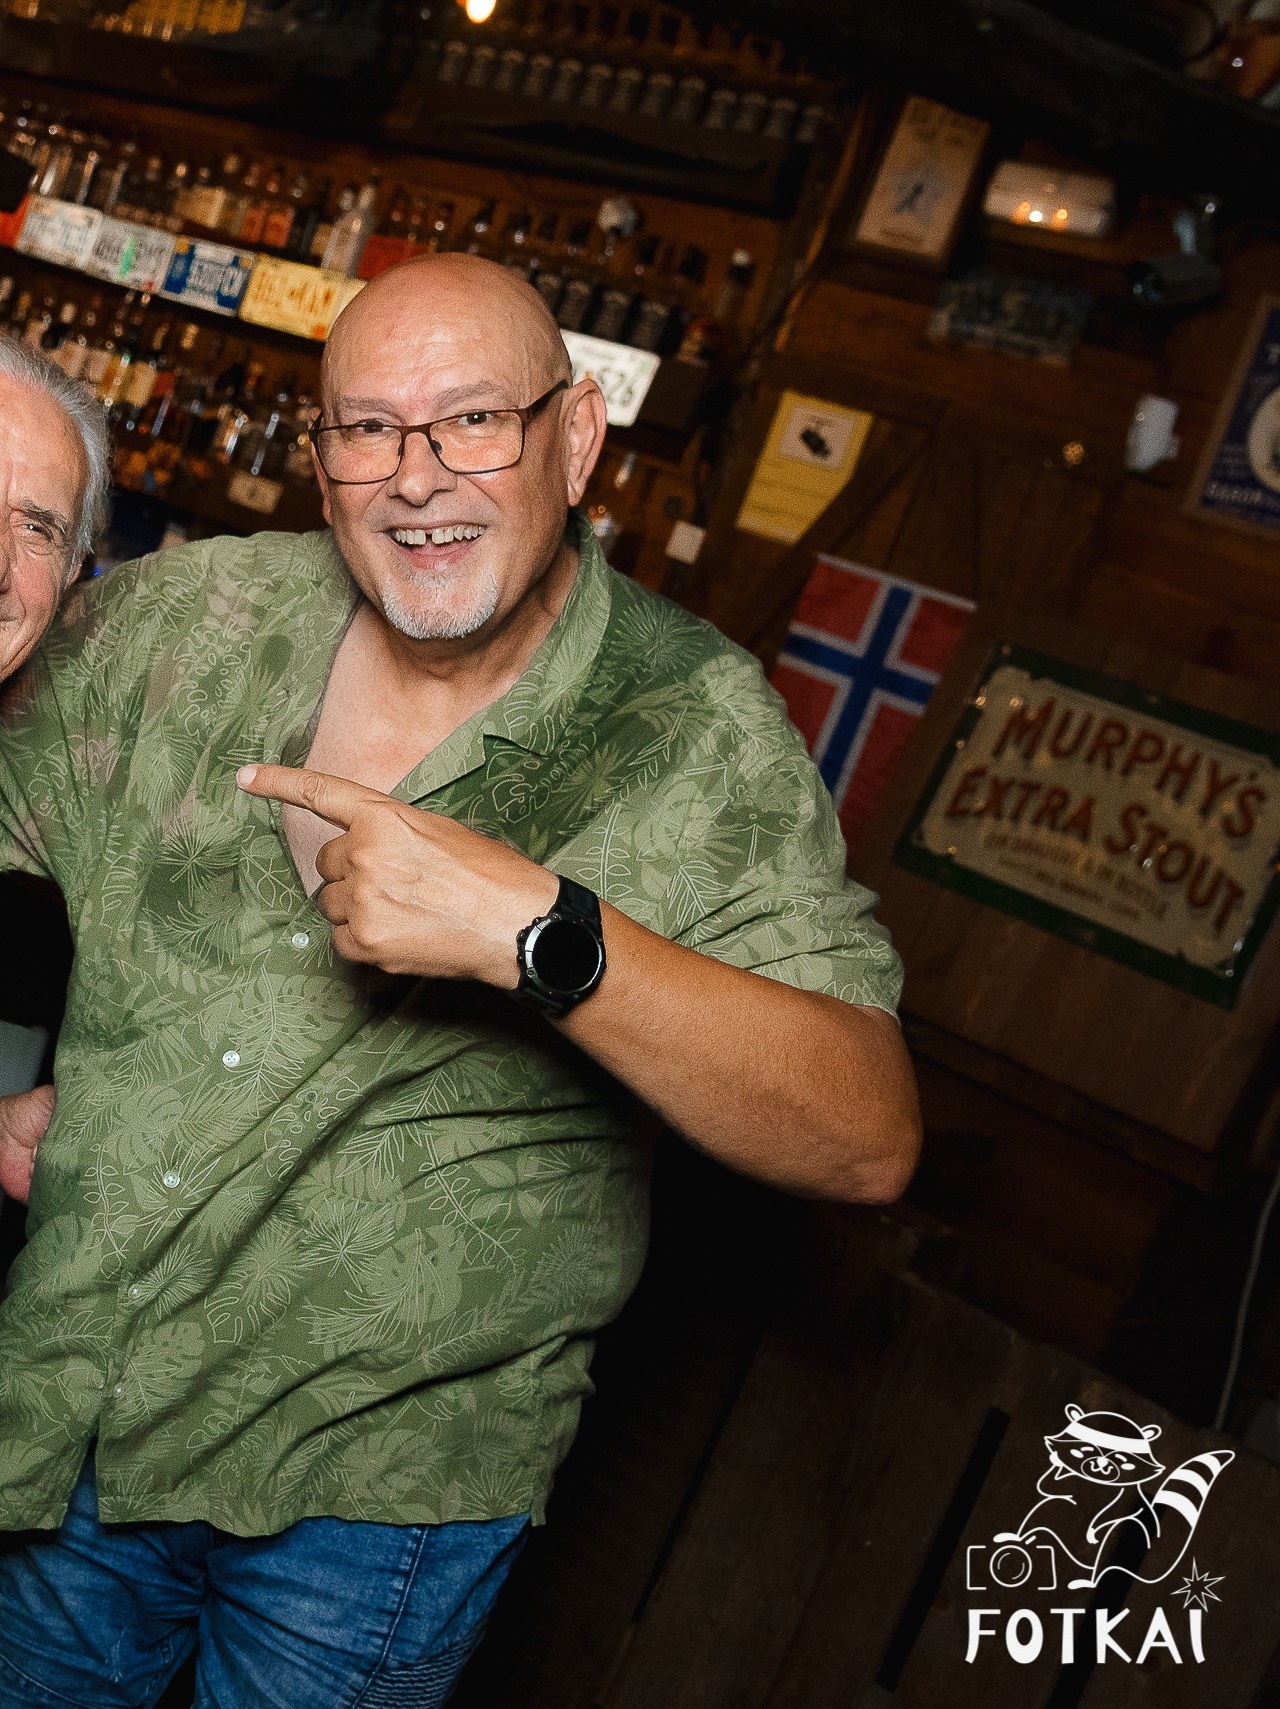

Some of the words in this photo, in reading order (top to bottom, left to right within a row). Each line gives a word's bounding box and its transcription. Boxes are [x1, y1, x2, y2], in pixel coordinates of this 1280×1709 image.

[991, 699, 1267, 839] MURPHY'S
[944, 765, 1099, 843] EXTRA
[1101, 804, 1246, 931] STOUT
